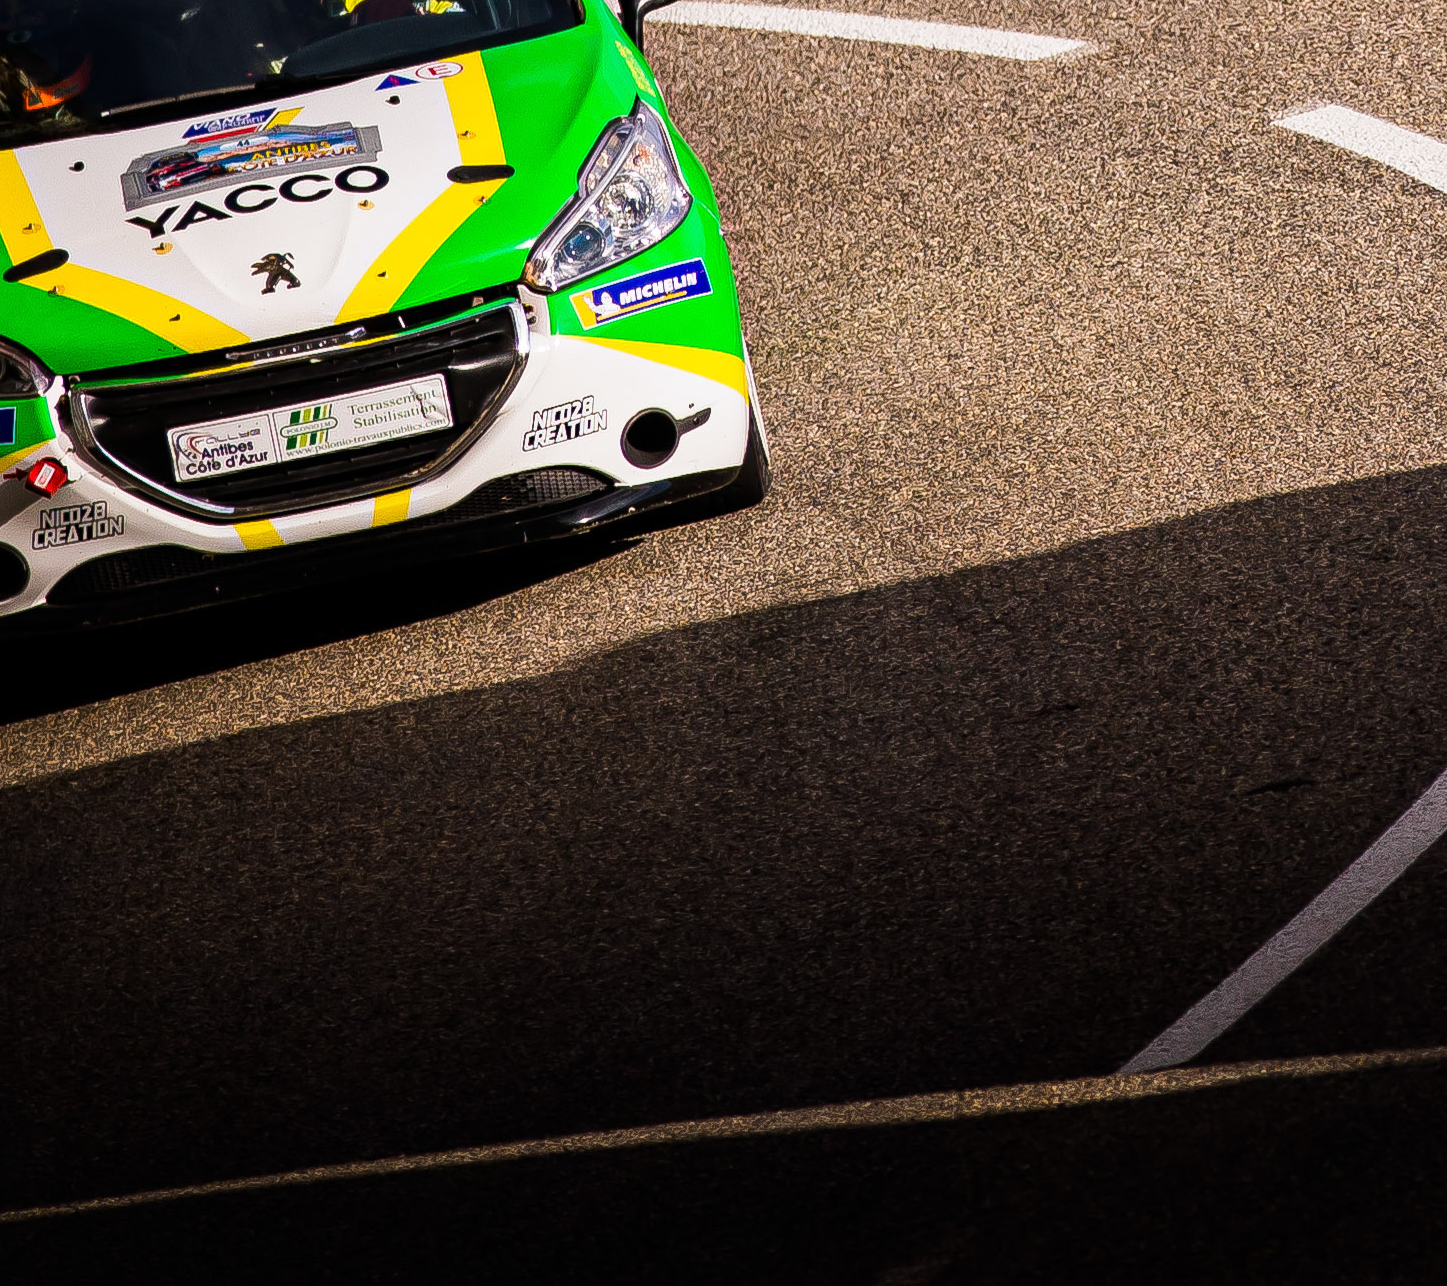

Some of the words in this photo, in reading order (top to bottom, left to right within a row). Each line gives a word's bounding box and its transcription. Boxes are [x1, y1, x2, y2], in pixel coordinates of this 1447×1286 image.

[124, 165, 390, 240] YACCO
[619, 272, 698, 306] MICHELIN
[347, 388, 437, 416] Terrassement
[354, 403, 437, 429] Stabilisation
[522, 409, 608, 452] CREATION
[201, 441, 254, 461] Antibes
[225, 451, 269, 469] d'Azur
[31, 515, 126, 551] CREATION
